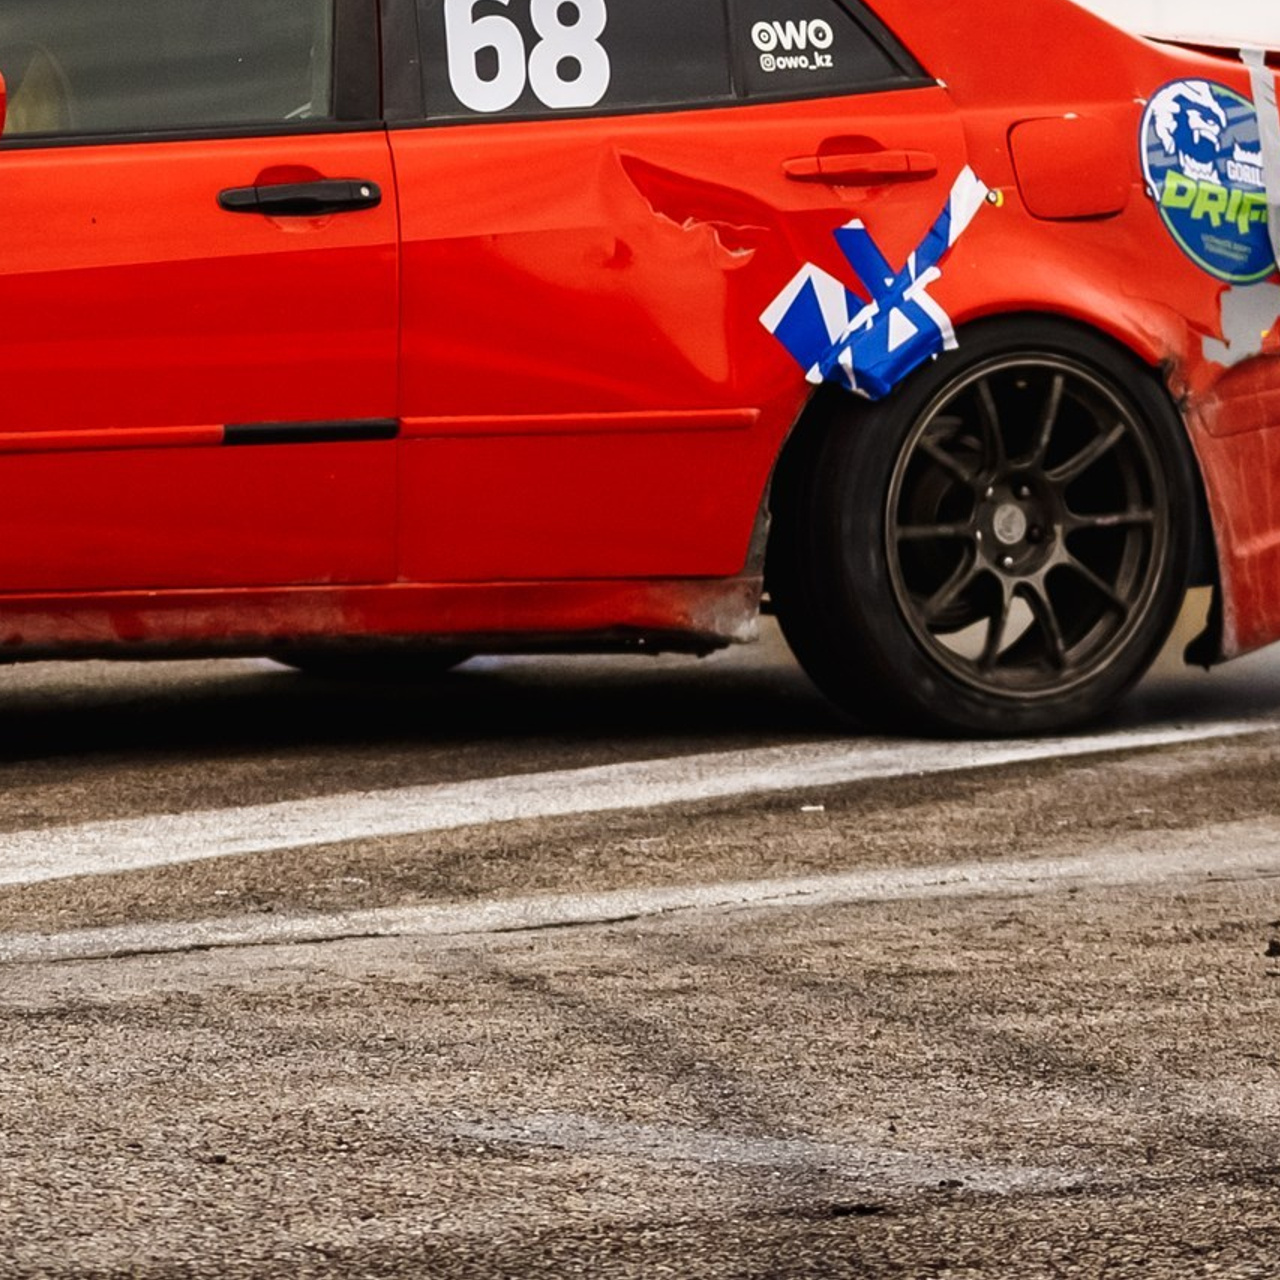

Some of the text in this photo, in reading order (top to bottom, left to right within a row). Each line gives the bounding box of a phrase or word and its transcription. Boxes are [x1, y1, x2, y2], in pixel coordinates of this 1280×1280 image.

[751, 19, 833, 52] OWO
[1226, 160, 1266, 187] GORIL
[1162, 170, 1268, 234] DRIF
